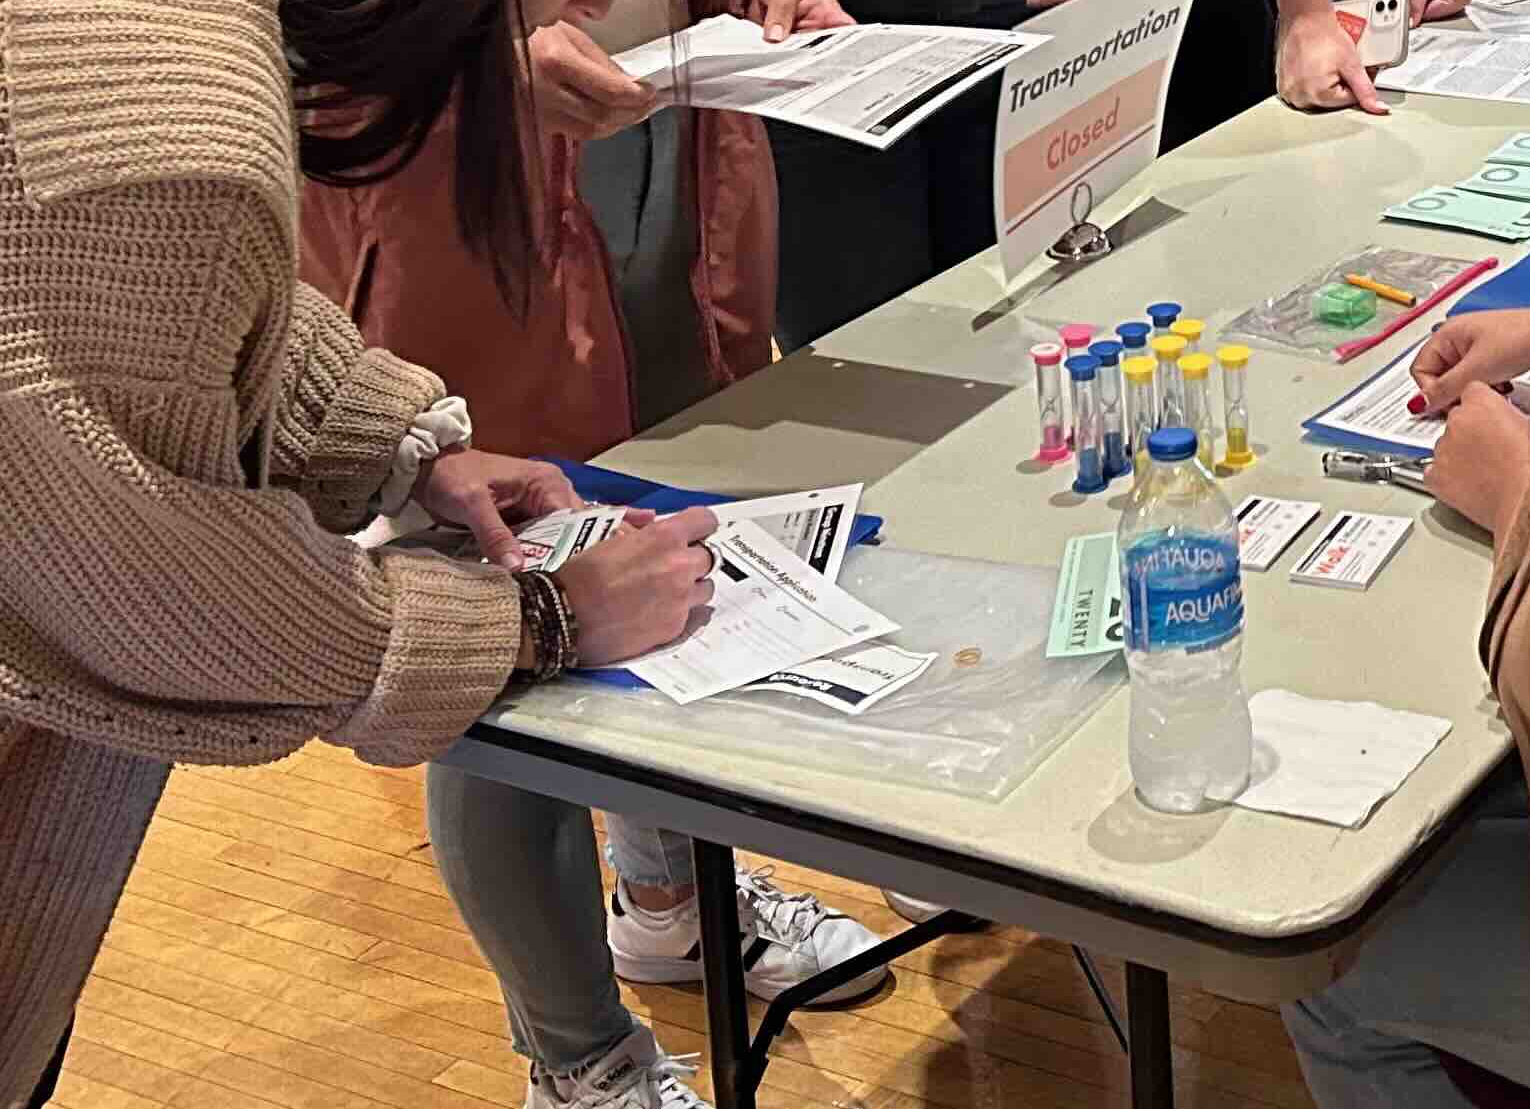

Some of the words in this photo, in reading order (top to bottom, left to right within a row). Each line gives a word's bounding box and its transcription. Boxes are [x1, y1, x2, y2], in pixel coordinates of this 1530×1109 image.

[1010, 6, 1181, 114] Transportation
[1045, 96, 1121, 171] Closed
[1070, 587, 1095, 650] TWENTY
